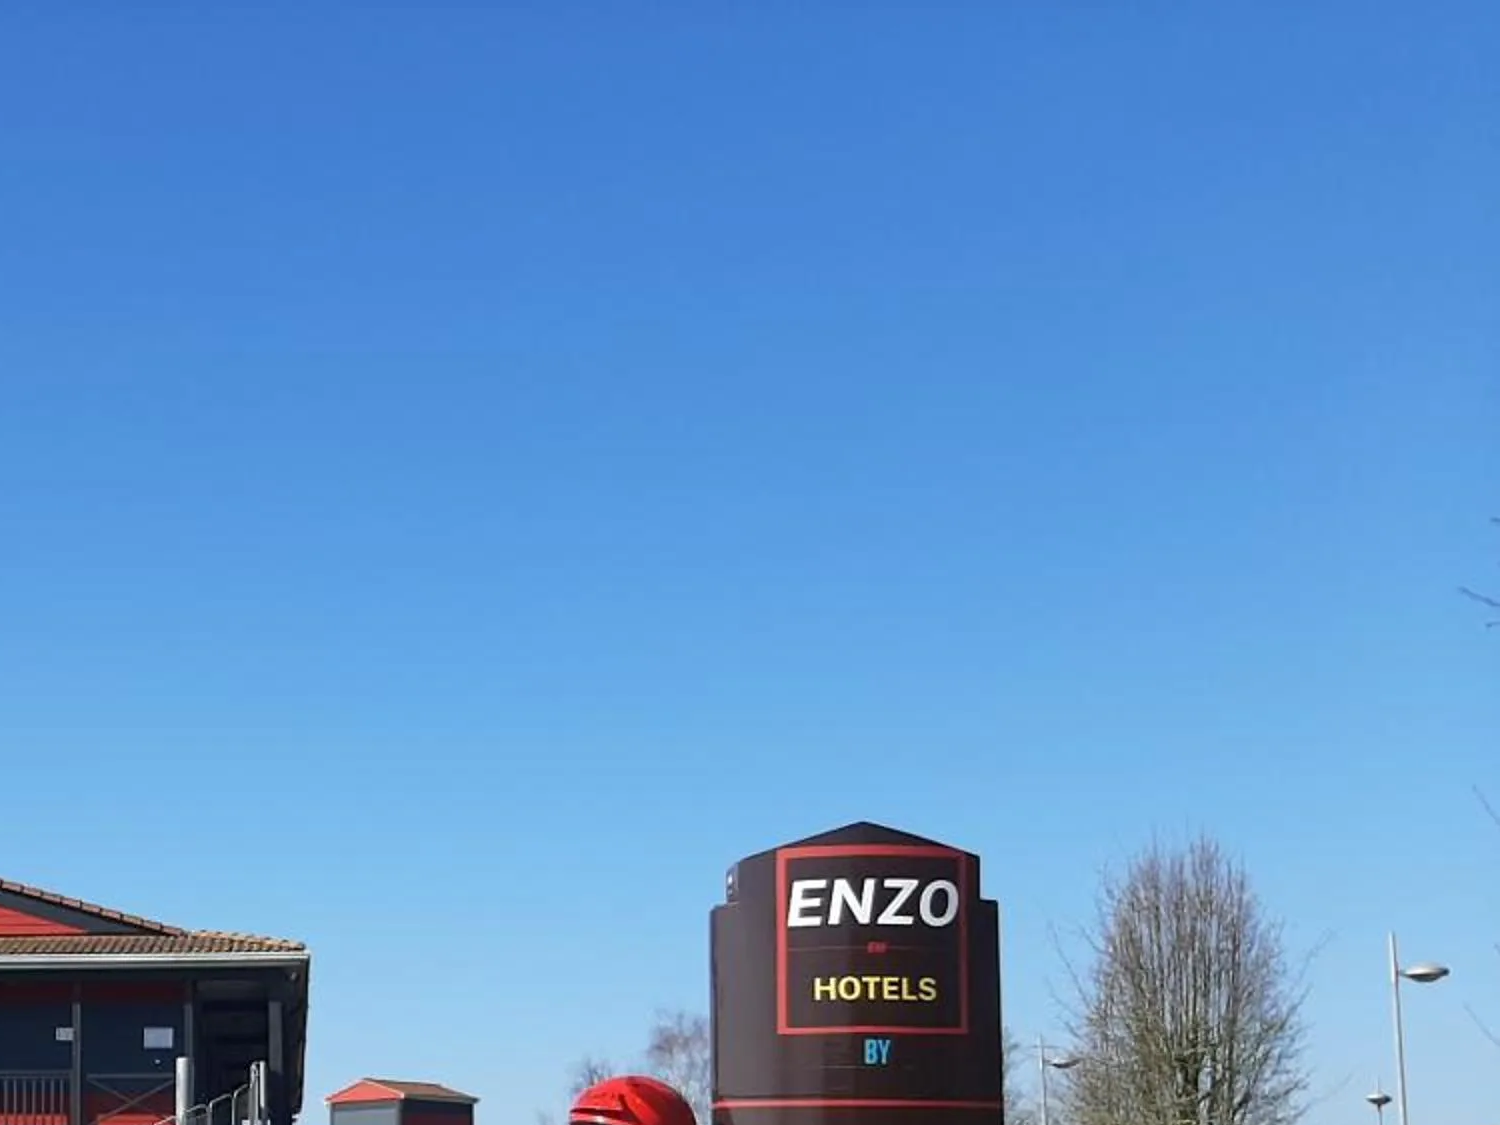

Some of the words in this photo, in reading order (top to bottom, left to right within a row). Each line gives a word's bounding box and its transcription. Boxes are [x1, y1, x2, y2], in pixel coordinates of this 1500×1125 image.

[787, 879, 959, 927] ENZO
[814, 977, 937, 1001] HOTELS
[864, 1039, 891, 1065] BY
